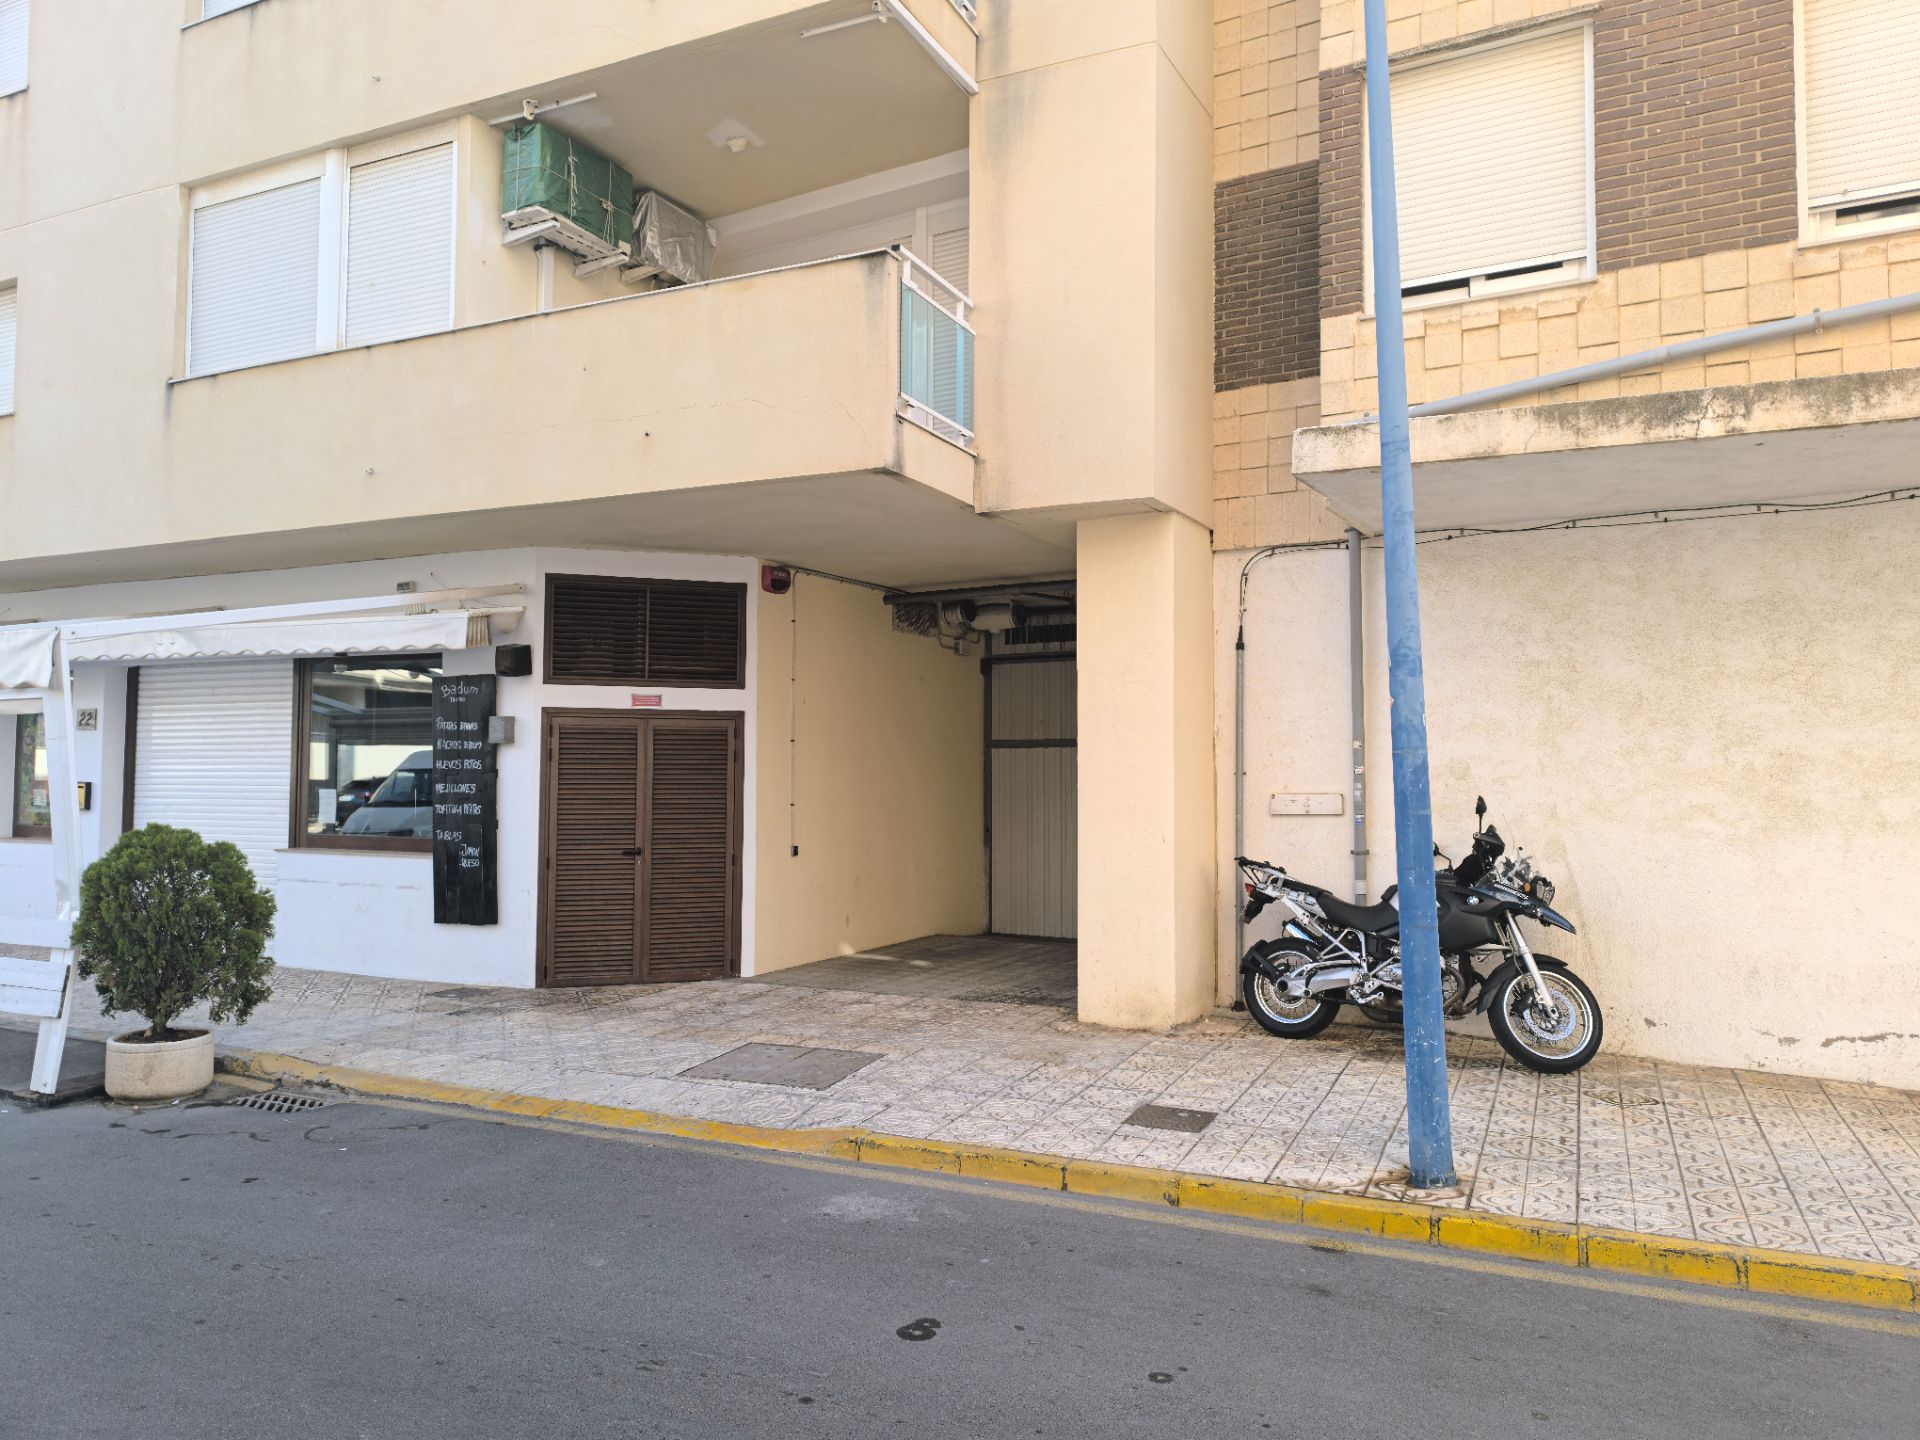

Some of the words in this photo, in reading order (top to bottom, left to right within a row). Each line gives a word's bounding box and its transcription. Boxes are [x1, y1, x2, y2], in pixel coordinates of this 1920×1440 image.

[440, 681, 479, 698] Badum
[78, 711, 93, 727] 22
[435, 759, 462, 770] HUEVOS
[463, 759, 482, 770] ROTOS
[435, 783, 476, 794] MEJILLONES
[435, 829, 462, 842] TABLAS
